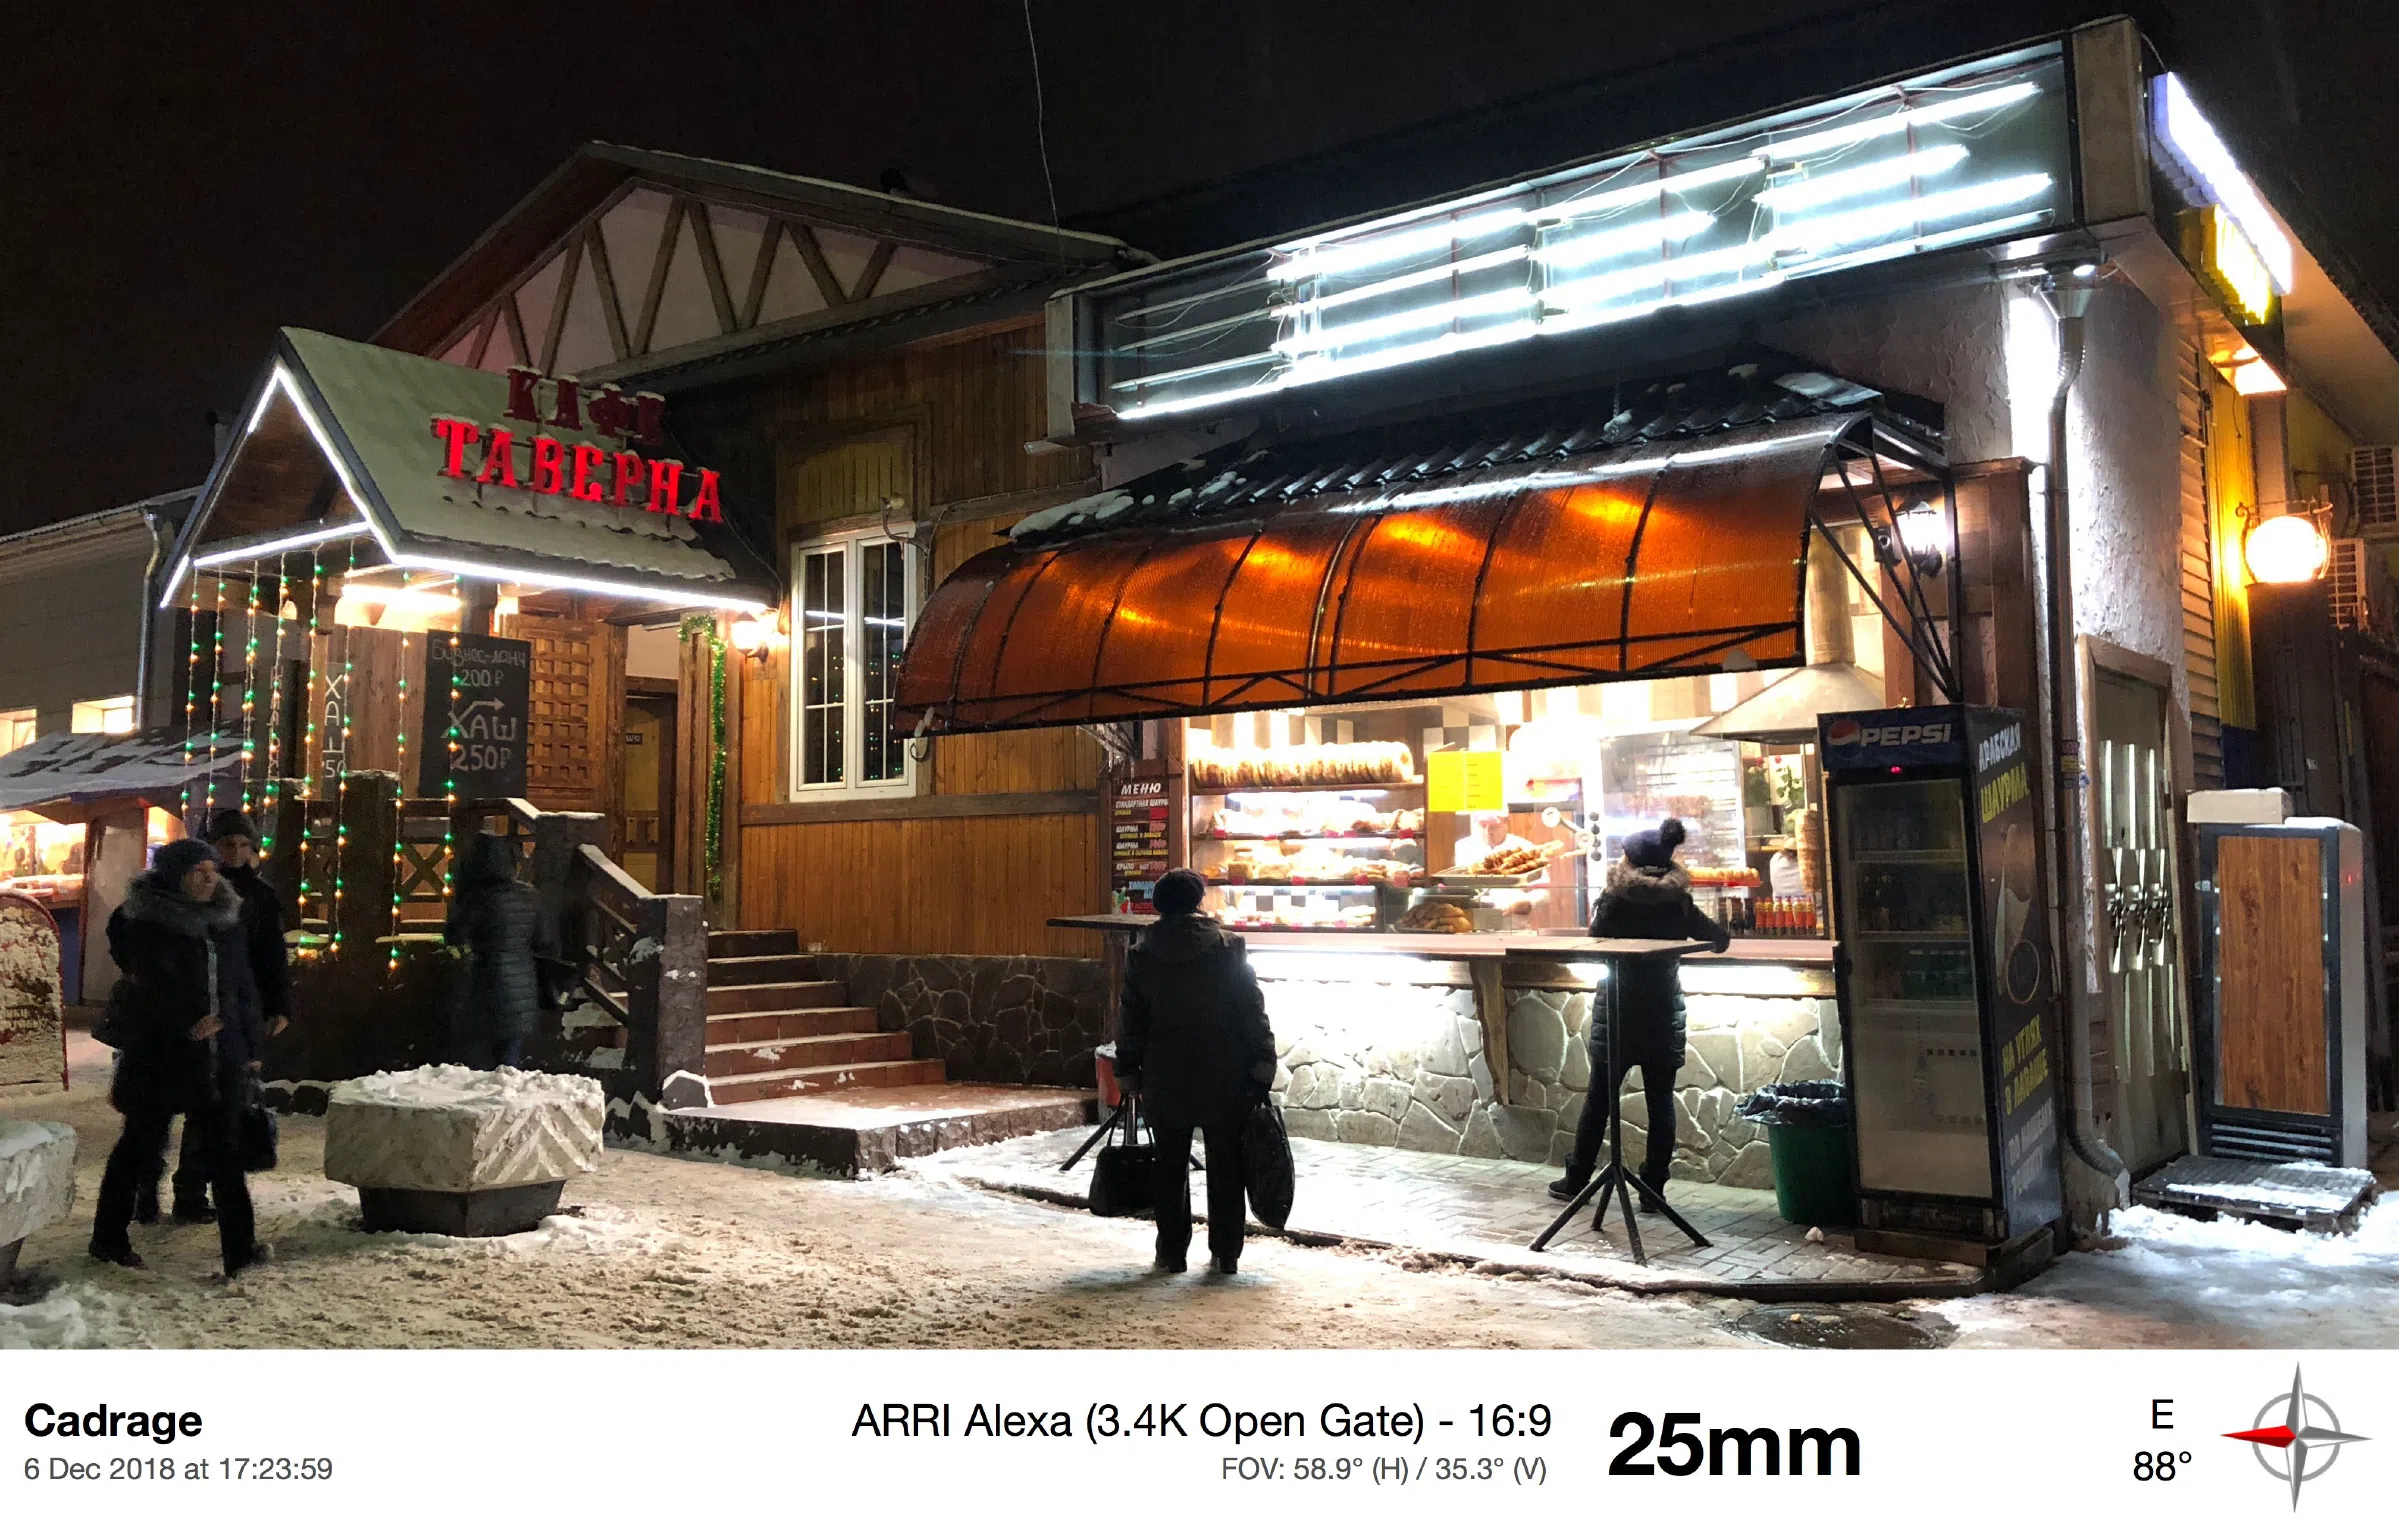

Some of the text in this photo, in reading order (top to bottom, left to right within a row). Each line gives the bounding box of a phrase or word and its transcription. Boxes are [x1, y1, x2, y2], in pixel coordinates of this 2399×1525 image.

[503, 366, 666, 447] КАФЕ
[431, 414, 722, 523] ТАВЕРНА
[441, 711, 517, 741] ХАШ
[1860, 723, 1952, 748] PEPSI
[1979, 721, 2021, 773] АРАБСКАЯ
[1121, 782, 1161, 795] МЕНЮ
[1980, 762, 2031, 823] ШАУРМА
